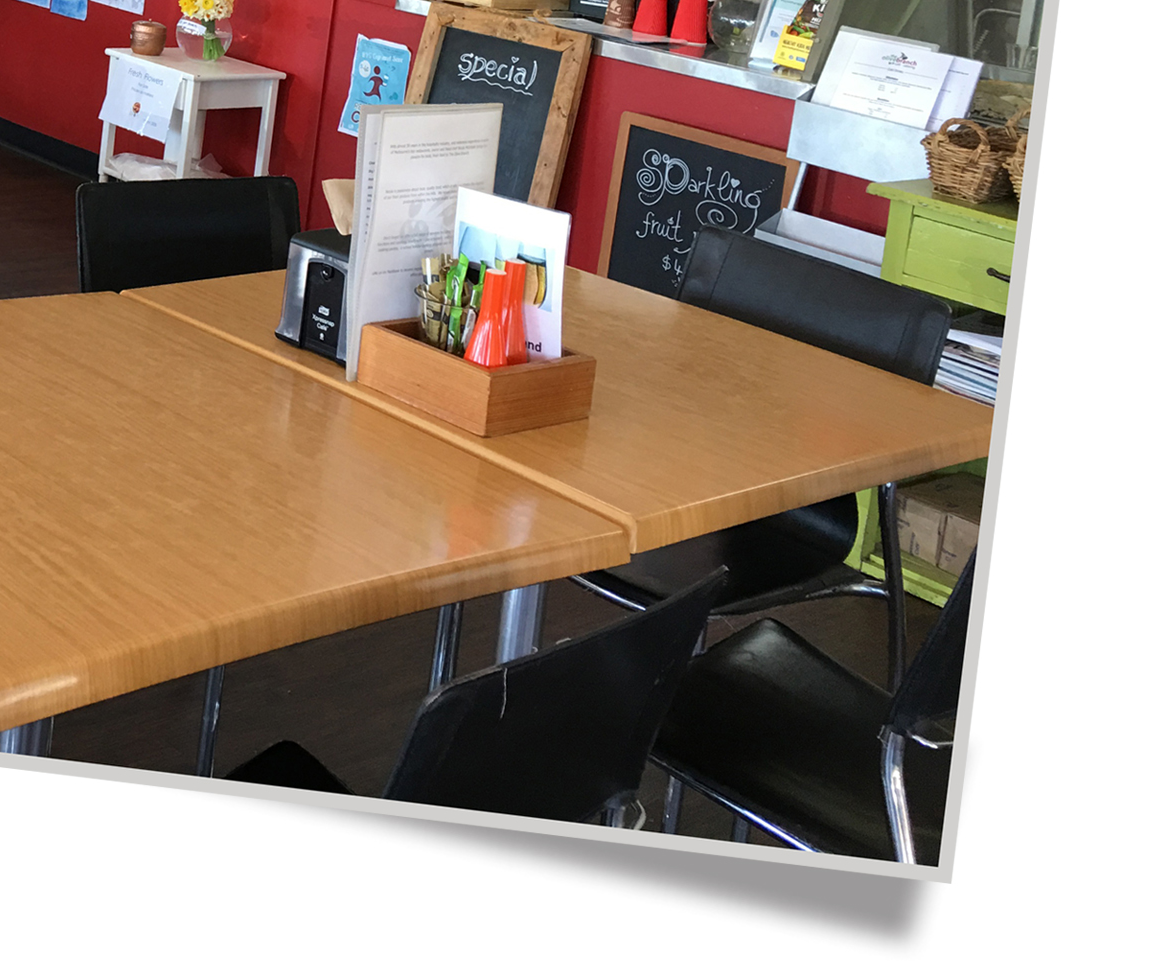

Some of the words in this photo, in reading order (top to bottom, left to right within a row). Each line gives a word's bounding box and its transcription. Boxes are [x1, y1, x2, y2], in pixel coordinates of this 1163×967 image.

[129, 67, 143, 79] Fresh
[144, 72, 164, 86] Flowers
[636, 210, 683, 243] fruit
